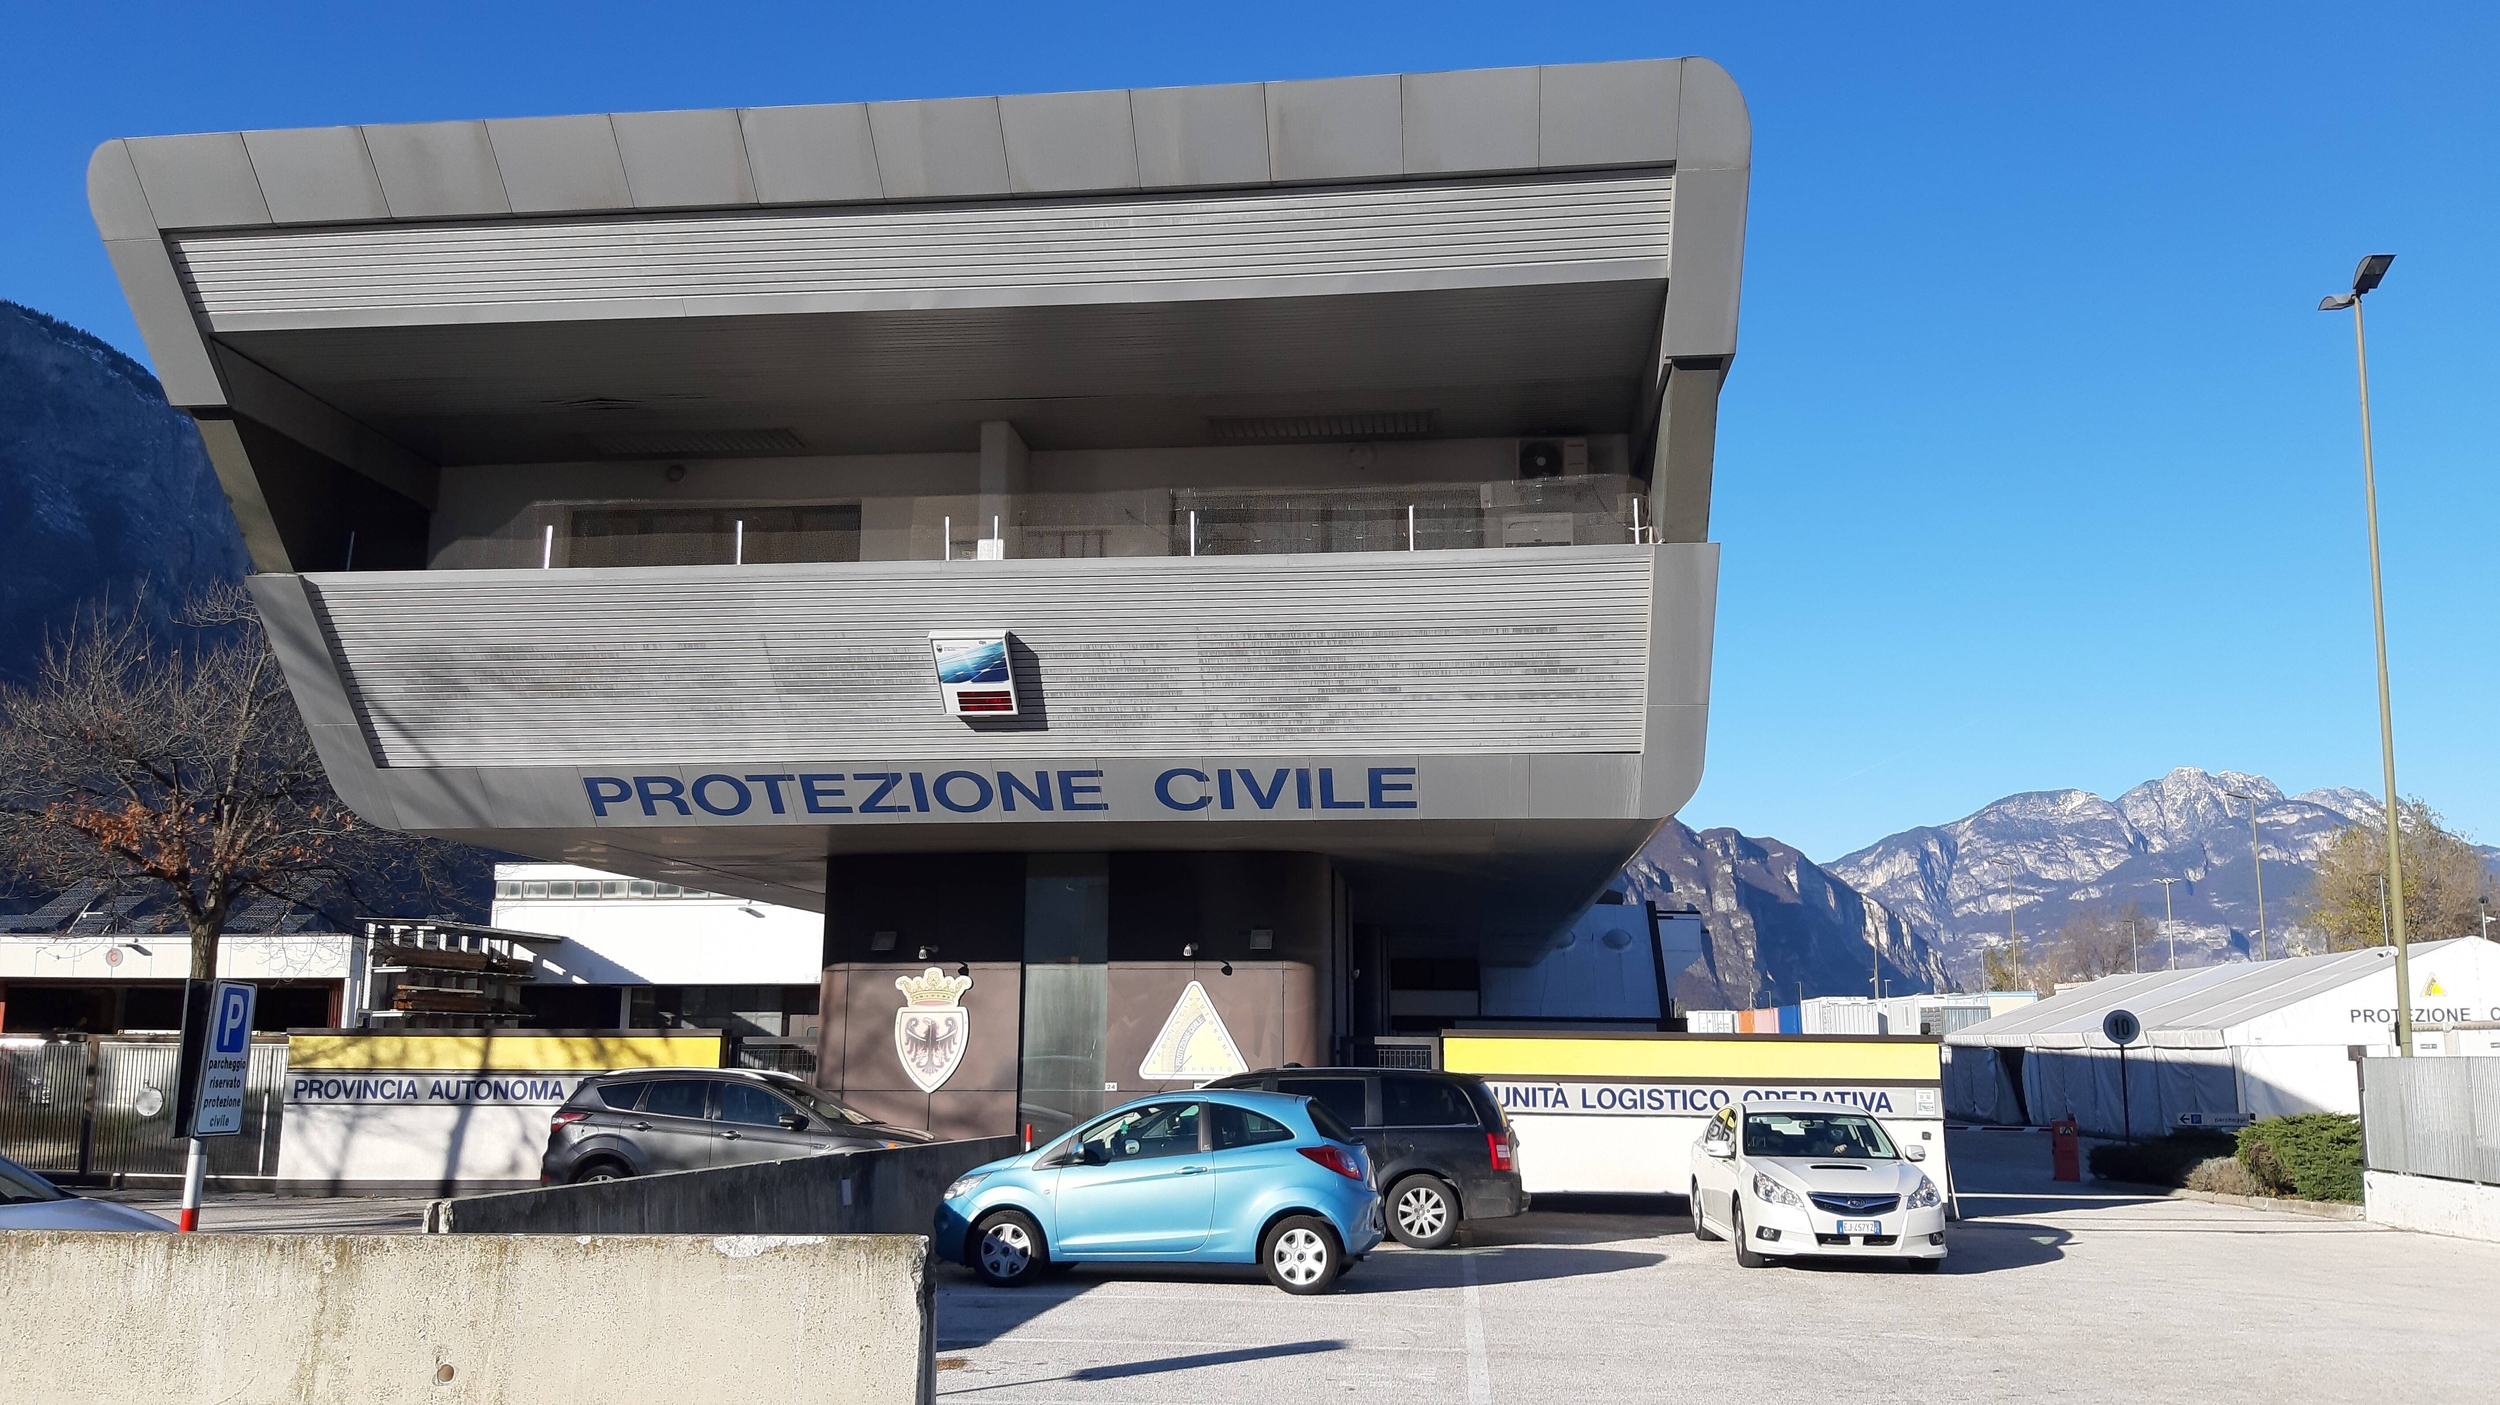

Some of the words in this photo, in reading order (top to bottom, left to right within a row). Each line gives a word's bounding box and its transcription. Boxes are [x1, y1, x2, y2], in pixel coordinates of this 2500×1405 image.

[582, 769, 1108, 817] PROTEZIONE
[1154, 767, 1418, 811] CIVILE
[223, 994, 245, 1047] P
[2115, 1018, 2130, 1036] 10
[208, 1056, 246, 1072] parcheggio
[209, 1075, 241, 1088] riservato
[293, 1079, 419, 1100] PROVINCIA
[428, 1079, 565, 1101] AUTONOMA
[203, 1095, 241, 1111] protezione
[1494, 1082, 1570, 1109] UNITÀ
[1581, 1087, 1731, 1112] LOGISTICO
[209, 1114, 230, 1127] civile
